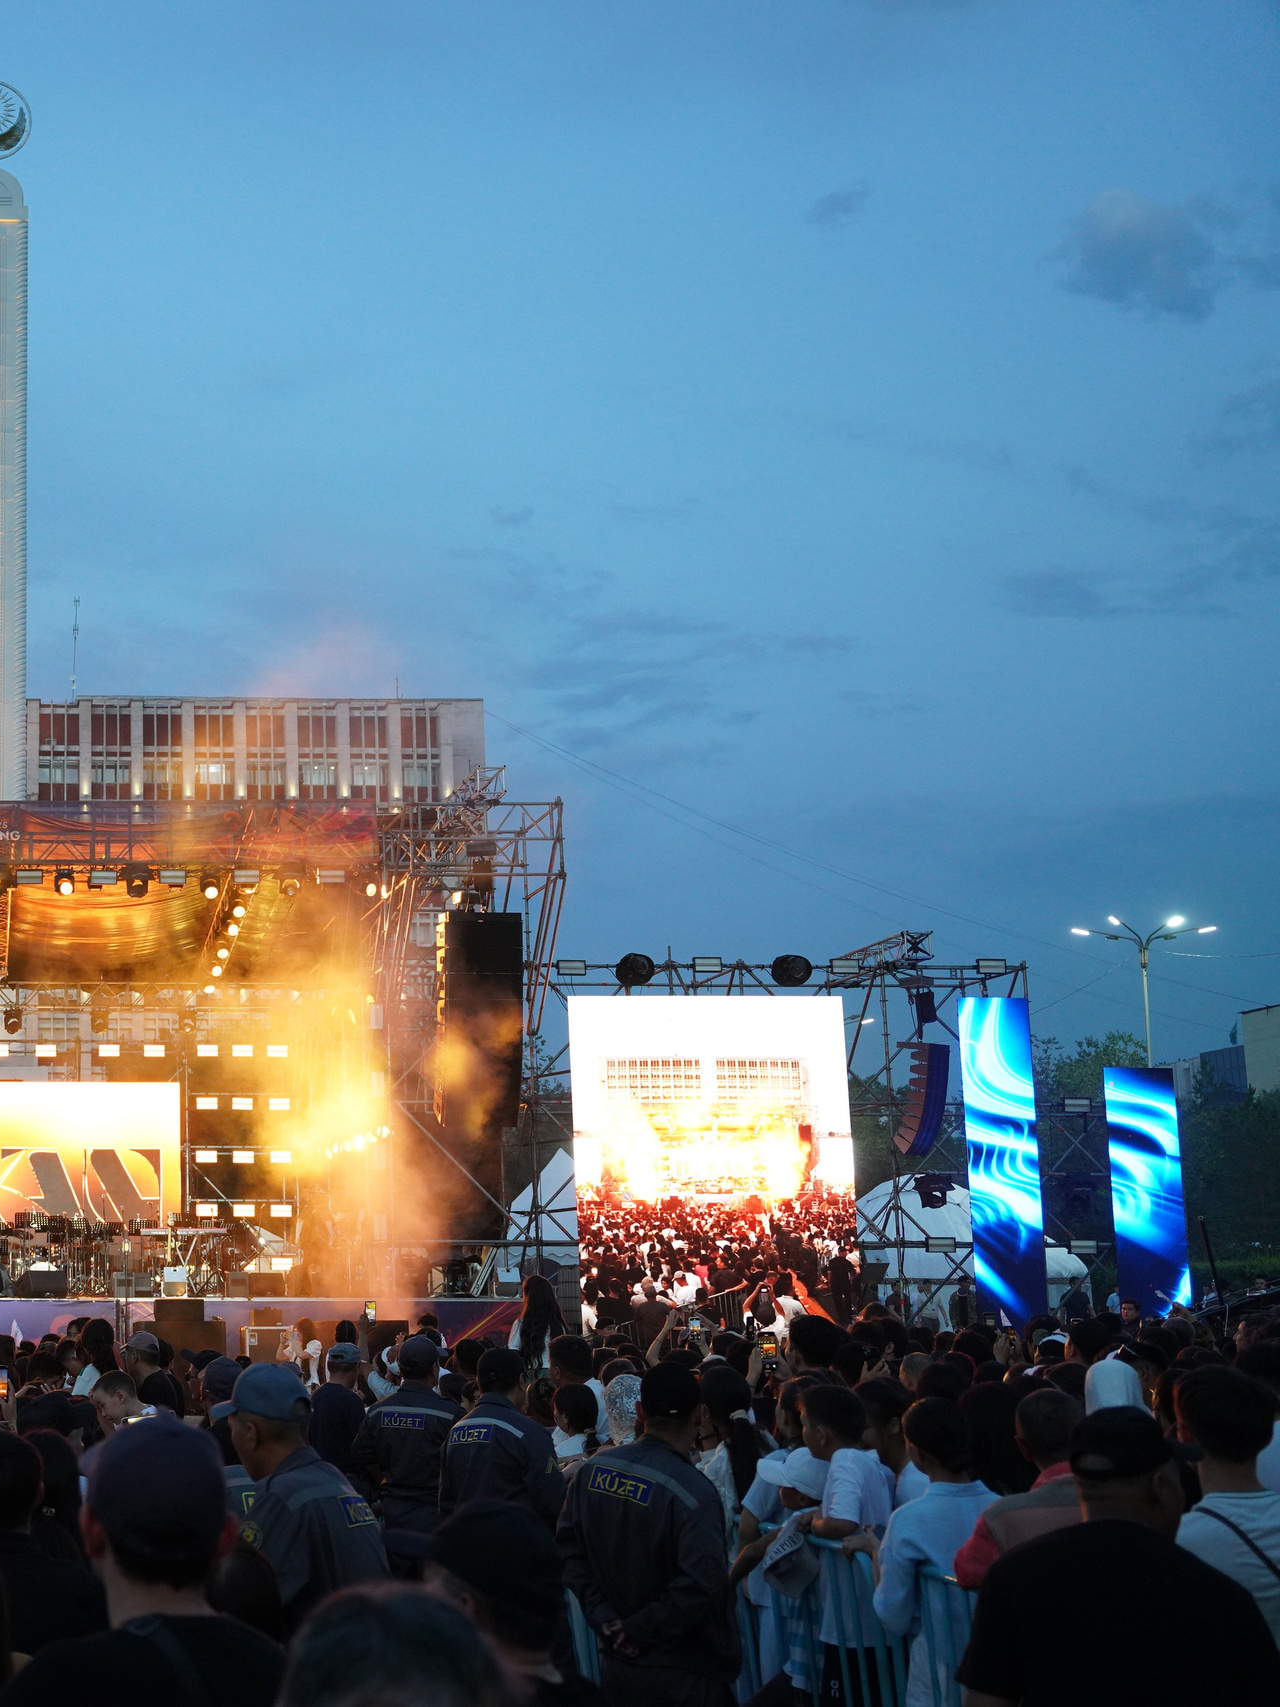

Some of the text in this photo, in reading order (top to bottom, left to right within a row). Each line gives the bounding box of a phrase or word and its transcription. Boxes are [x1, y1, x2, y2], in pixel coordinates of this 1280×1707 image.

[384, 1413, 422, 1427] KÚZET
[452, 1426, 488, 1442] KÚZET
[595, 1472, 647, 1500] KÚZET
